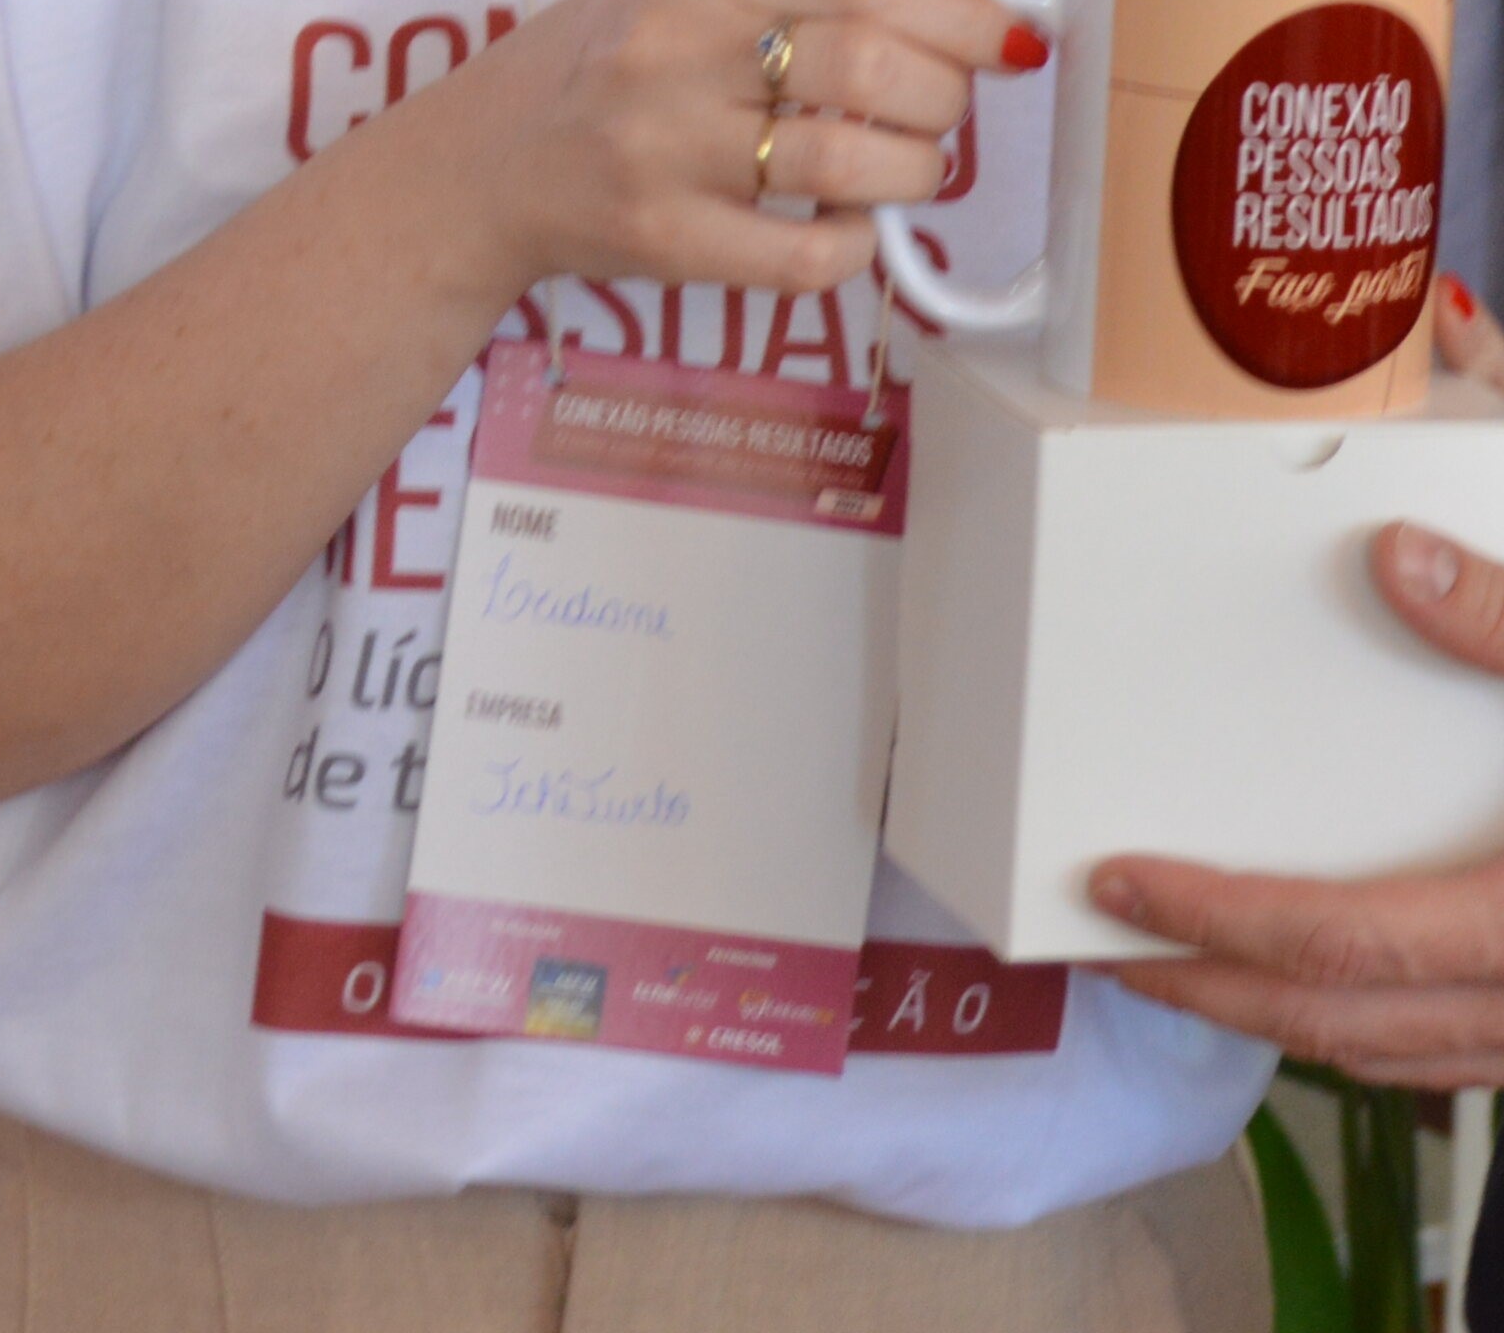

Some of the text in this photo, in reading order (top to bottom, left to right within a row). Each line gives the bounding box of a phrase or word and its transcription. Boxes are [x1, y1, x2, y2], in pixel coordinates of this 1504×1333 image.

[1240, 73, 1411, 139] CONEXÃO
[1237, 135, 1403, 194] PESSOAS
[1232, 183, 1435, 250] RESULTADOS
[491, 502, 557, 542] NOME
[465, 688, 562, 731] EMPRESA
